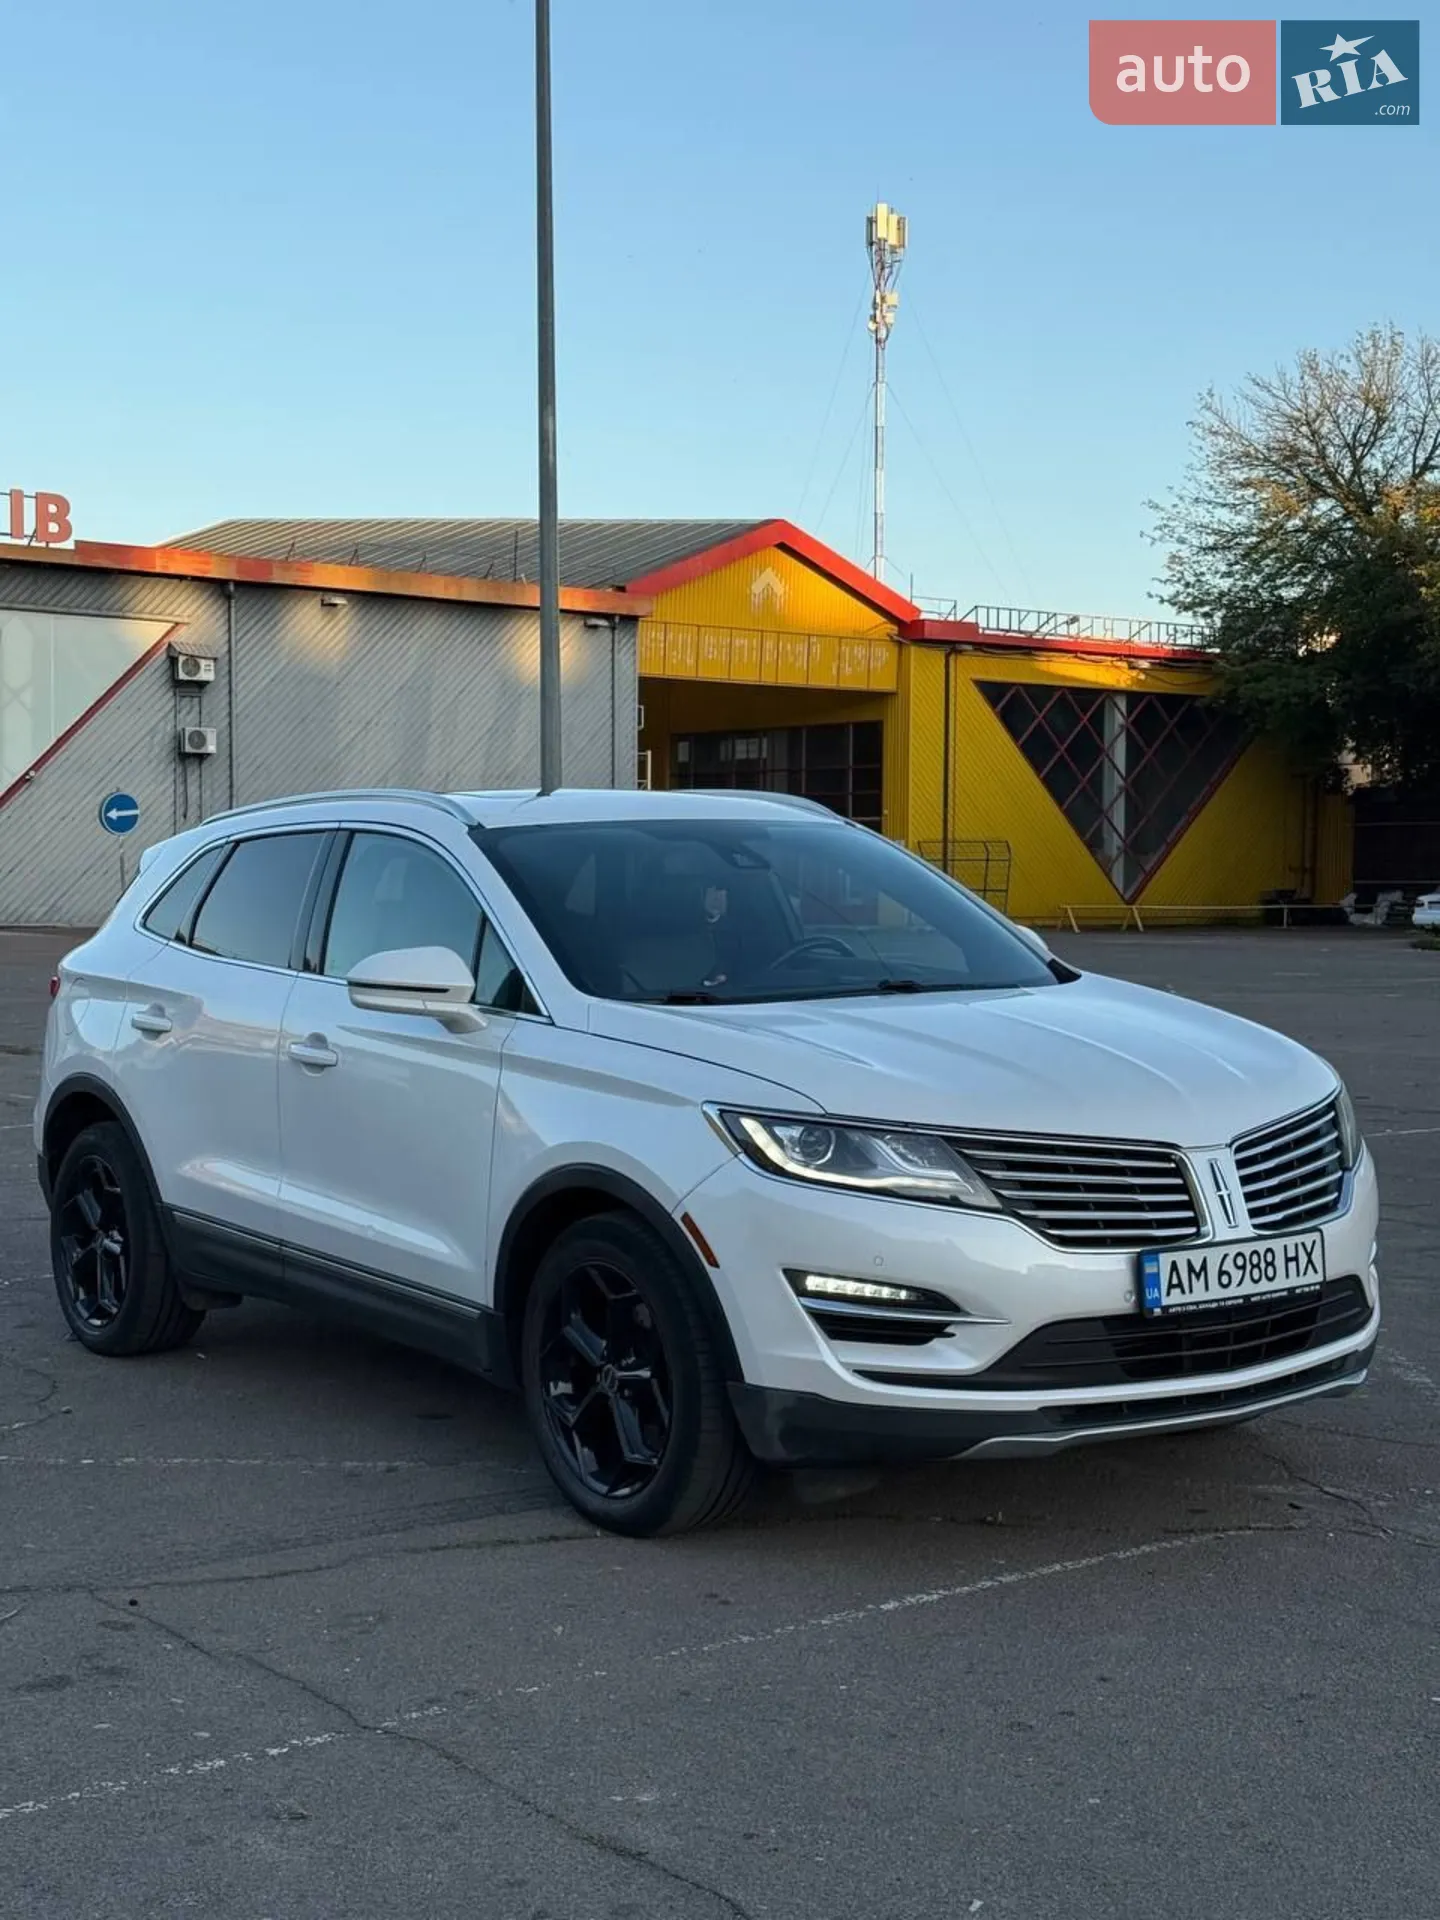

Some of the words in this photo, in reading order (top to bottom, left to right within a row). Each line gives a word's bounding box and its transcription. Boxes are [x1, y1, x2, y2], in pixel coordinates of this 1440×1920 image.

[1165, 1256, 1210, 1297] AM
[1217, 1247, 1277, 1289] 6988
[1283, 1239, 1319, 1279] HX
[1145, 1287, 1160, 1300] UA
